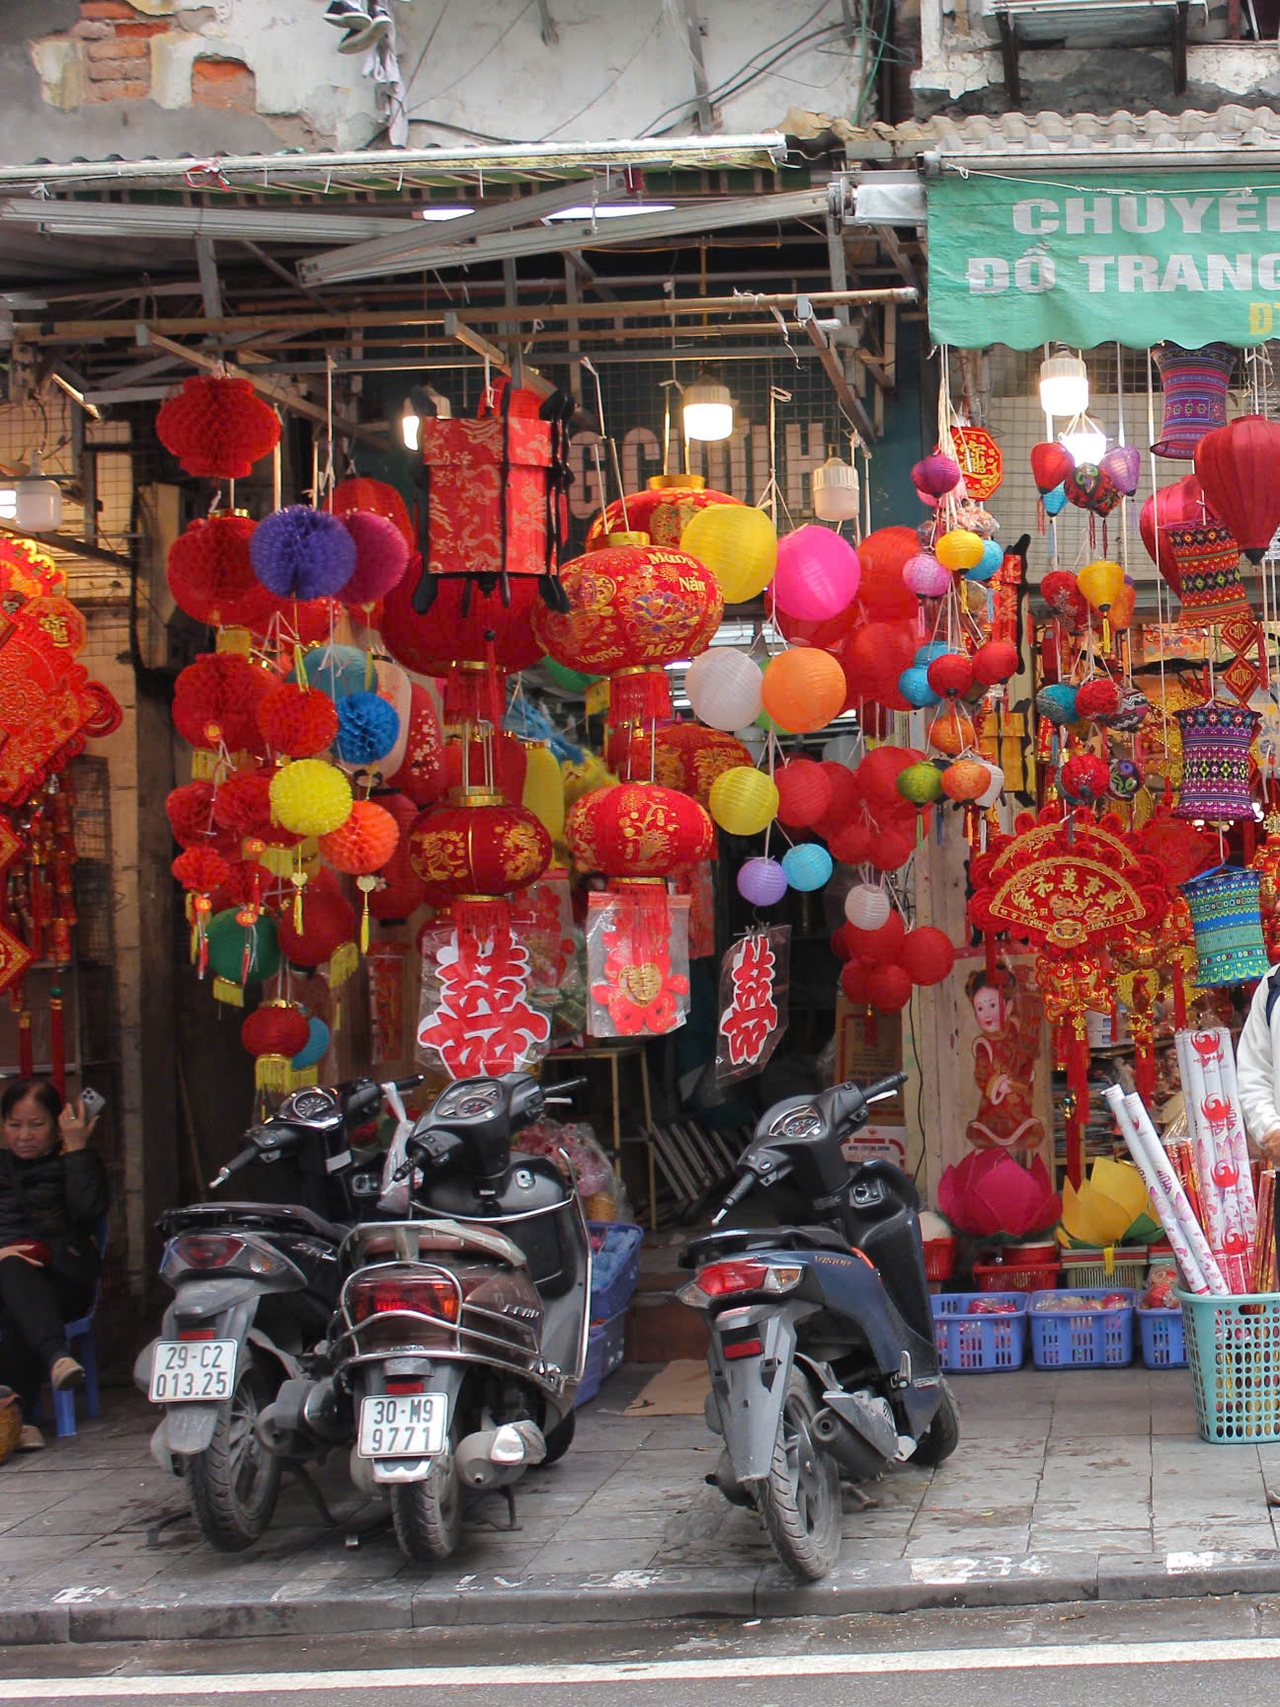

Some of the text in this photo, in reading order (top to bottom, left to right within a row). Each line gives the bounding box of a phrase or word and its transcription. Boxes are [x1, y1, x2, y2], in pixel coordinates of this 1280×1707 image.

[965, 241, 1056, 294] ĐỒ
[165, 1345, 223, 1370] 29-C2
[156, 1371, 229, 1398] 013.25
[373, 1398, 434, 1425] 30-M9
[371, 1426, 430, 1452] 9771
